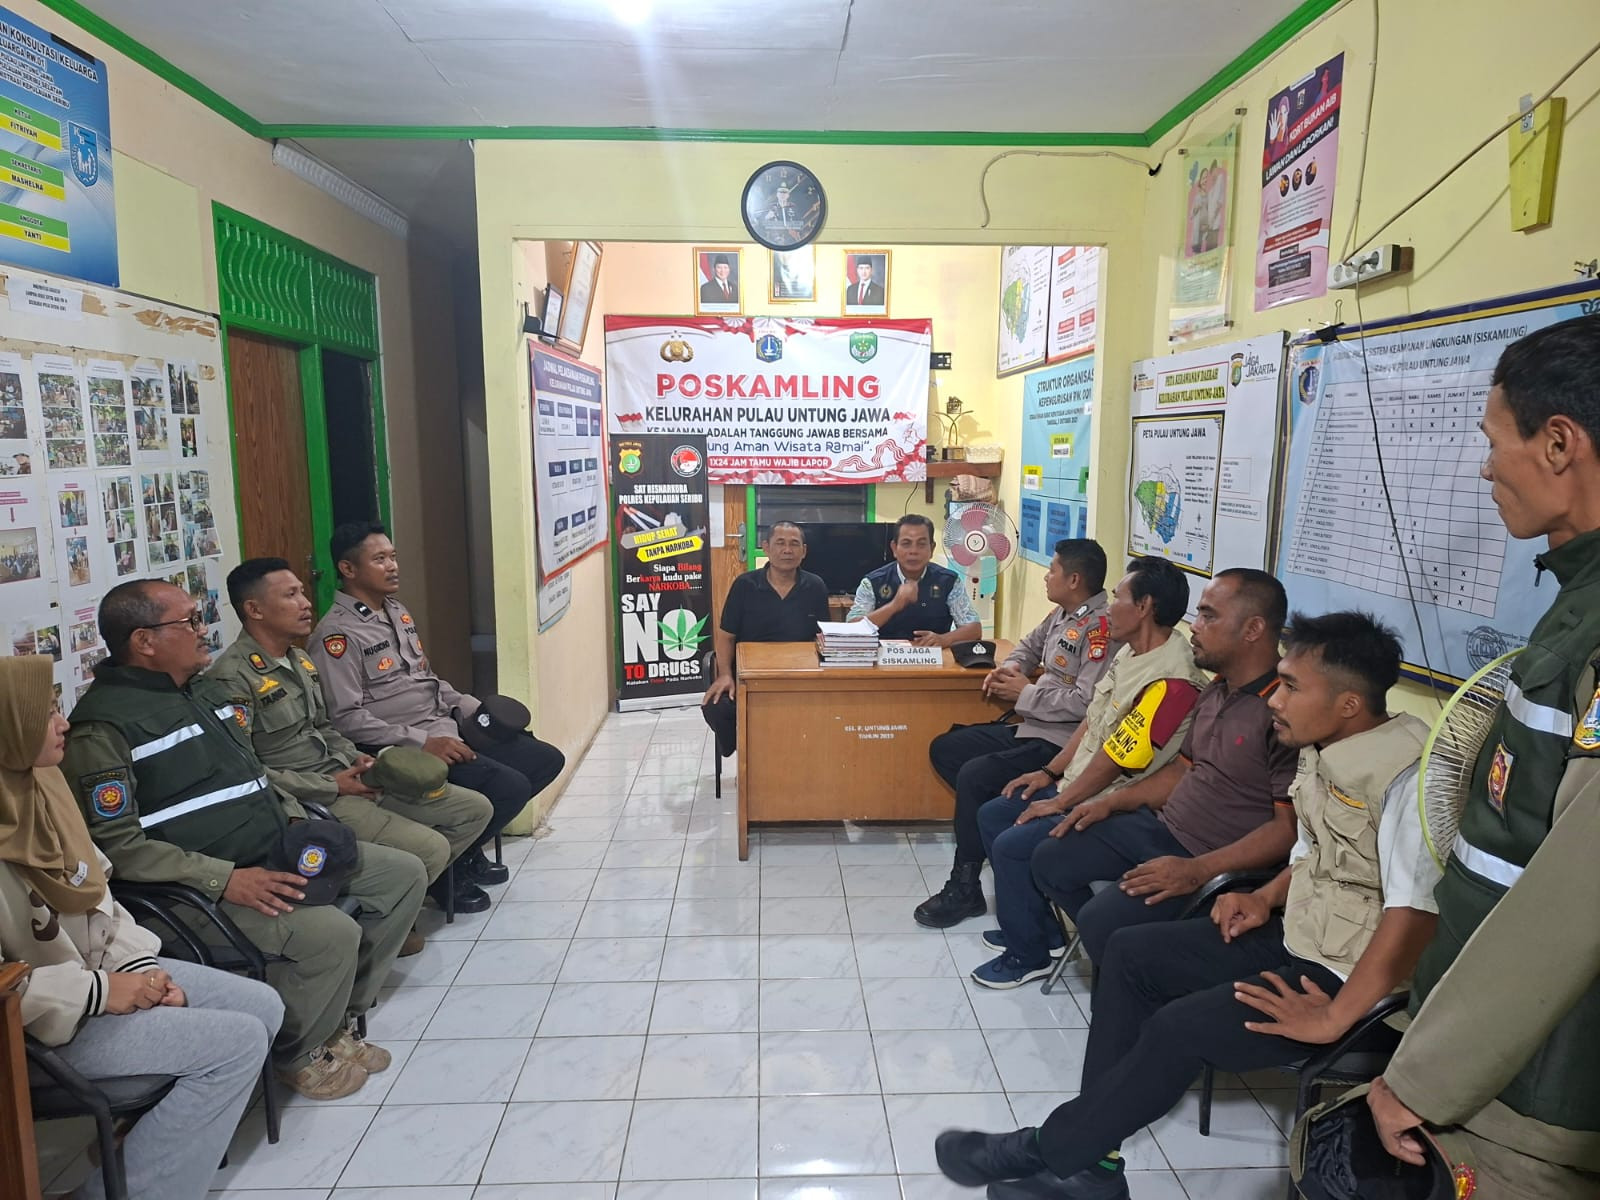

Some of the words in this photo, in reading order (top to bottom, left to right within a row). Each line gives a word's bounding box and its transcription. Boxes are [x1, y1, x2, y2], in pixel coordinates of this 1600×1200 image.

[10, 27, 58, 61] KONSULTASI
[59, 53, 98, 81] KELUARGA
[11, 173, 44, 191] MASHELNA
[24, 229, 42, 241] YANTI
[1368, 346, 1389, 358] SISTEM
[1389, 342, 1424, 354] KEAMANAN
[1426, 334, 1471, 349] LINGKUNGAN
[1473, 325, 1528, 345] (SISKAMLING)
[1419, 358, 1449, 369] UNTUNG
[1449, 354, 1471, 366] JAWA
[657, 374, 879, 398] POSKAMLING
[1037, 375, 1062, 394] STRUKTUR
[646, 407, 733, 421] KELURAHAN
[737, 408, 783, 422] PULAU
[788, 408, 847, 422] UNTUNG
[851, 407, 890, 422] JAWA
[707, 427, 747, 438] ADALAH
[749, 428, 804, 438] TANGGUNG
[806, 428, 840, 438] JAWAB
[842, 427, 888, 438] BERSAMA
[1143, 429, 1153, 438] PETA
[1154, 429, 1168, 438] PULAU
[1170, 428, 1189, 438] UNTUNG
[1190, 427, 1206, 438] JAWA
[734, 441, 769, 452] Aman
[774, 441, 821, 452] Wisata
[731, 457, 748, 466] JAM
[750, 458, 771, 466] TAMU
[773, 458, 799, 467] WAJIB
[801, 458, 828, 467] LAPOR
[645, 545, 665, 558] TANPA
[666, 539, 695, 552] NARKOBA
[653, 564, 676, 573] Siapa
[663, 572, 683, 582] kudu
[684, 571, 702, 582] pake
[621, 592, 661, 613] SAY
[622, 608, 698, 664] NO
[1057, 638, 1077, 655] POLRI
[882, 657, 936, 665] SISKAMLING
[624, 664, 645, 680] TO
[648, 659, 700, 678] DRUGS
